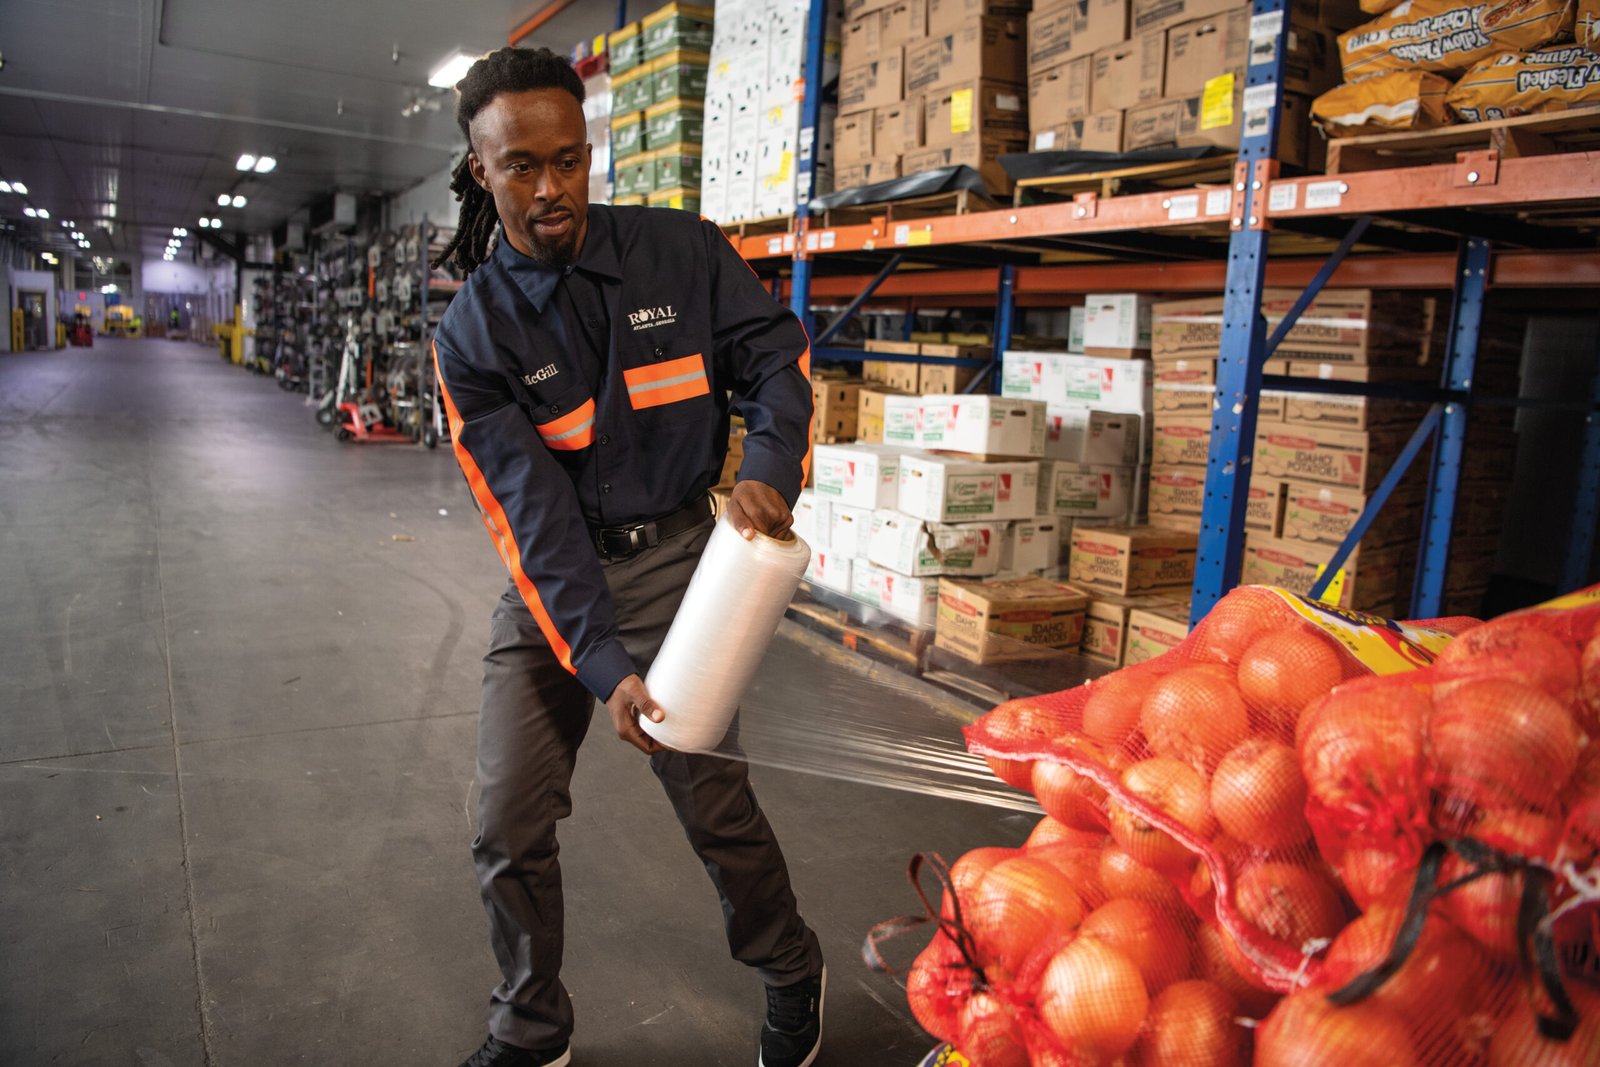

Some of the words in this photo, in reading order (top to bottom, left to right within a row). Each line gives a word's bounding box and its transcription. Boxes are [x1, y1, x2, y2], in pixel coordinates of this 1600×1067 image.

[1442, 29, 1491, 53] Yellow
[1517, 66, 1588, 91] Fleshed
[520, 363, 559, 386] McGill
[1296, 451, 1333, 464] IDAHO
[1287, 461, 1338, 477] POTATOES
[1095, 556, 1119, 567] IDAHO
[1088, 564, 1123, 577] POTATOES
[955, 613, 977, 628] IDAHO
[1032, 622, 1065, 634] IDAHO
[1023, 632, 1067, 645] POTATOES
